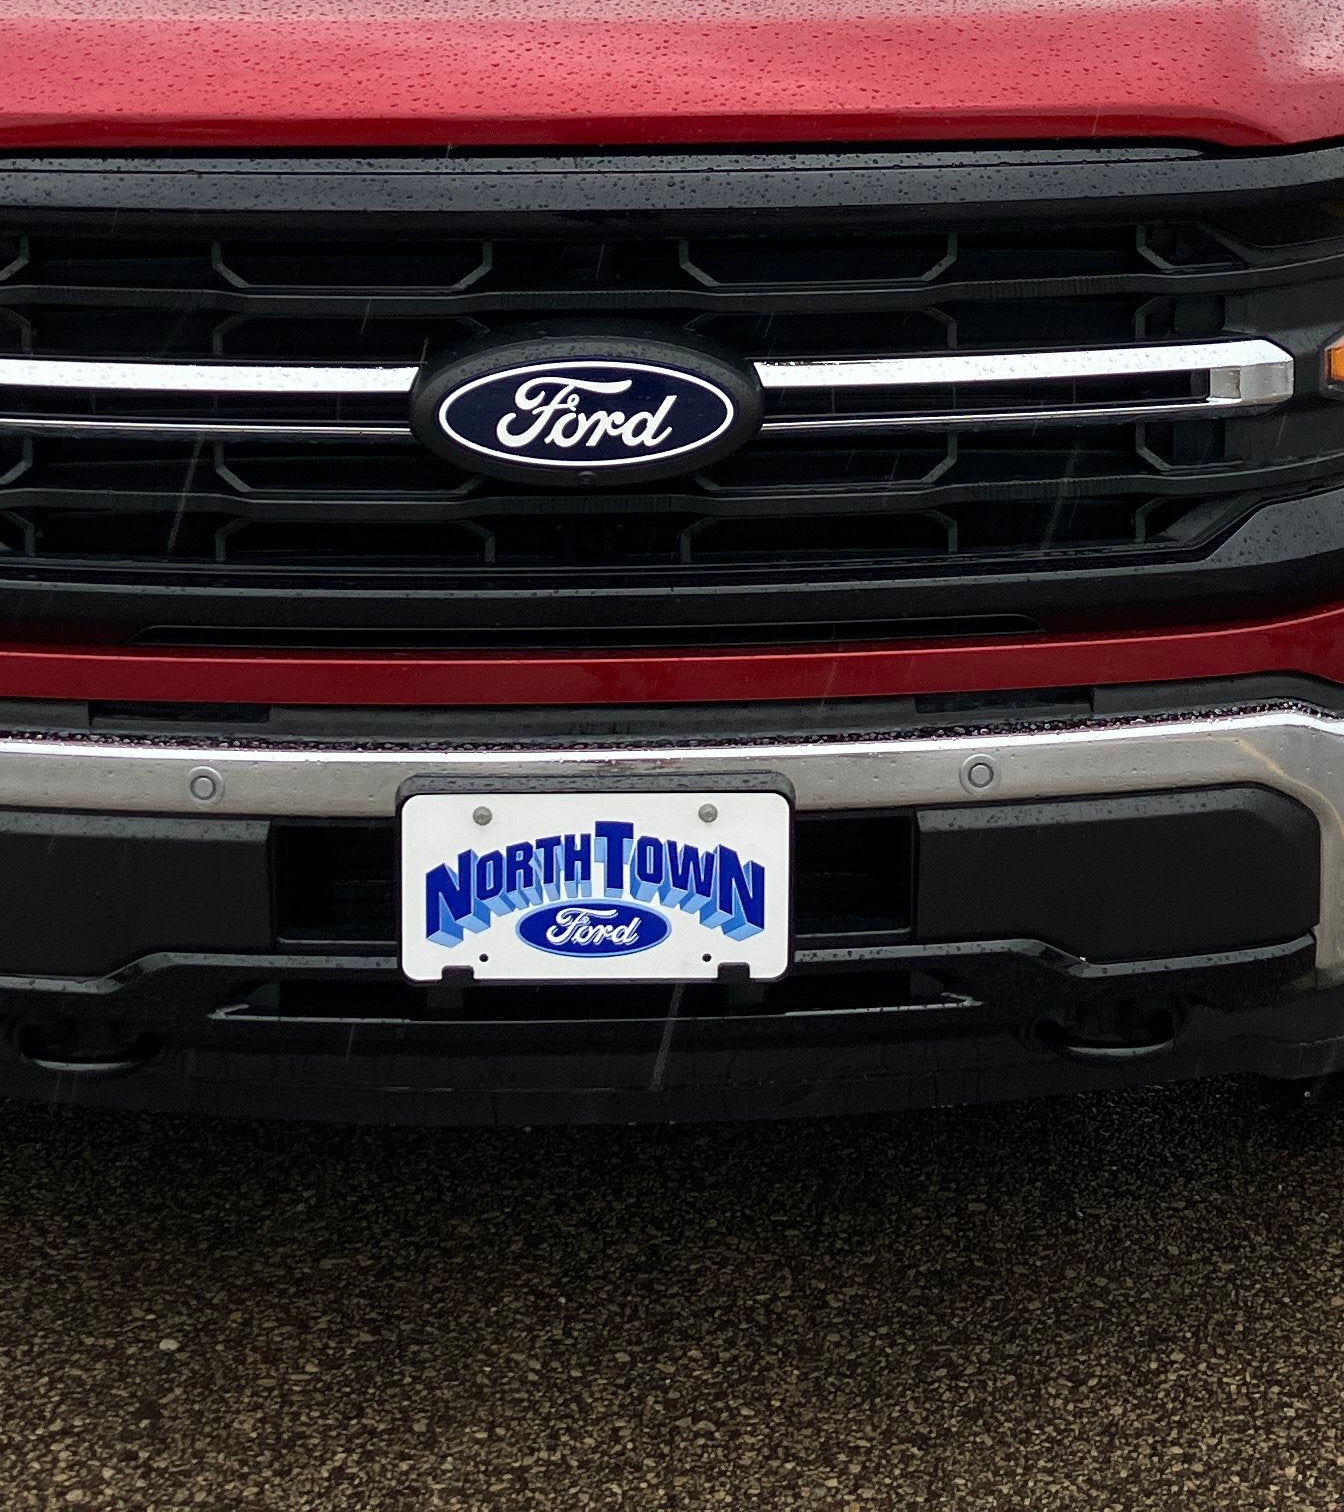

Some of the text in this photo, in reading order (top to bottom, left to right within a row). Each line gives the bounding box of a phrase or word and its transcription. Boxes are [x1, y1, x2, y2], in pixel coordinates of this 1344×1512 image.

[496, 376, 678, 448] Ford
[425, 820, 766, 946] NORTHTOWN
[546, 907, 643, 946] Ford
